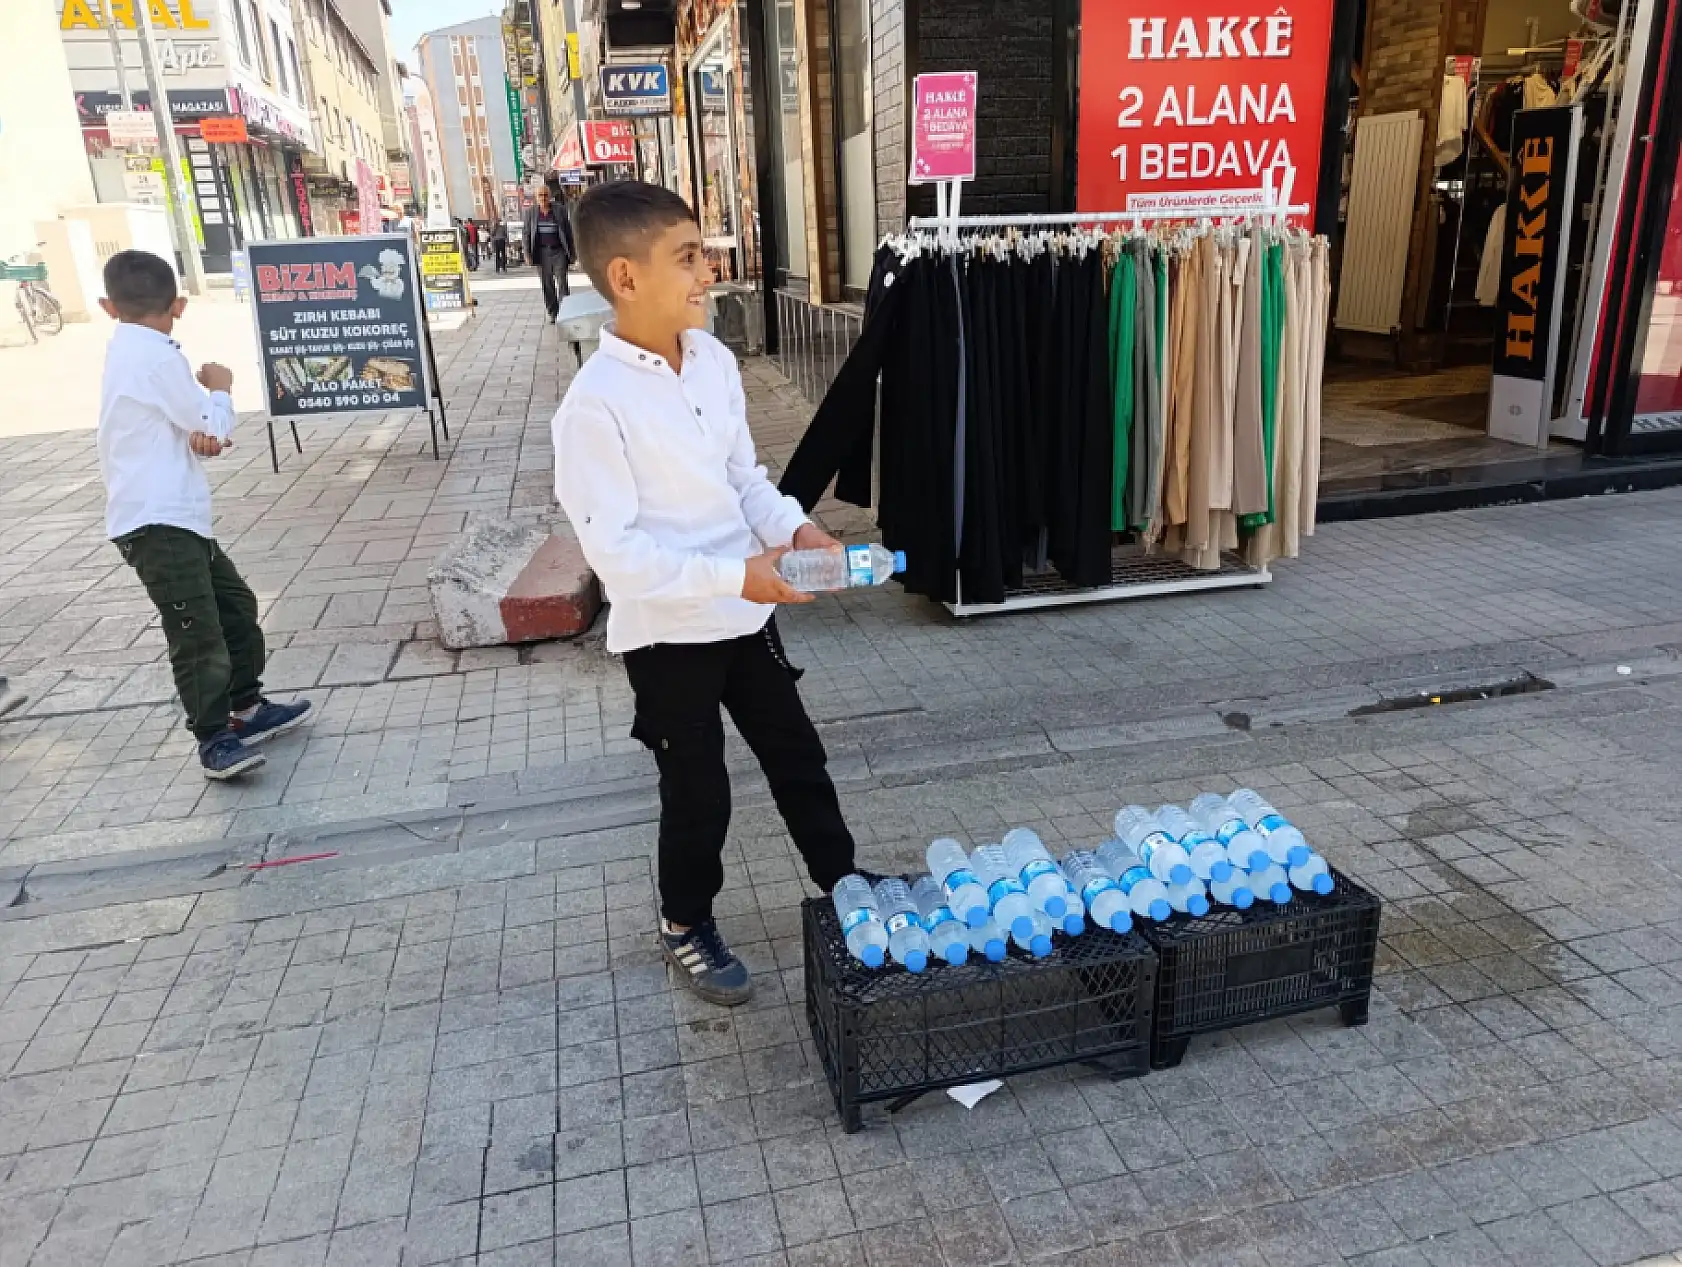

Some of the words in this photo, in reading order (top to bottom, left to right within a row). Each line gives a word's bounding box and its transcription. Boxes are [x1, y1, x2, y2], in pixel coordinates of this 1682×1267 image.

[61, 0, 209, 29] ARAL
[1127, 5, 1293, 60] HAKKÊ
[608, 72, 661, 92] KVK
[933, 107, 968, 119] ALANA
[1117, 85, 1144, 128] 2
[1153, 82, 1297, 127] ALANA
[1110, 143, 1128, 181] 1
[1140, 138, 1293, 180] BEDAVA
[1130, 197, 1156, 208] Tüm
[1159, 194, 1217, 207] Ürünlerde
[293, 310, 327, 324] ZIRH
[331, 308, 381, 321] KEBABI
[270, 327, 297, 341] SÜT
[301, 327, 340, 340] KUZU
[342, 323, 408, 338] KOKOREÇ
[312, 381, 337, 392] ALO
[342, 378, 382, 391] PAKET
[362, 393, 380, 404] 00
[383, 392, 400, 403] 04
